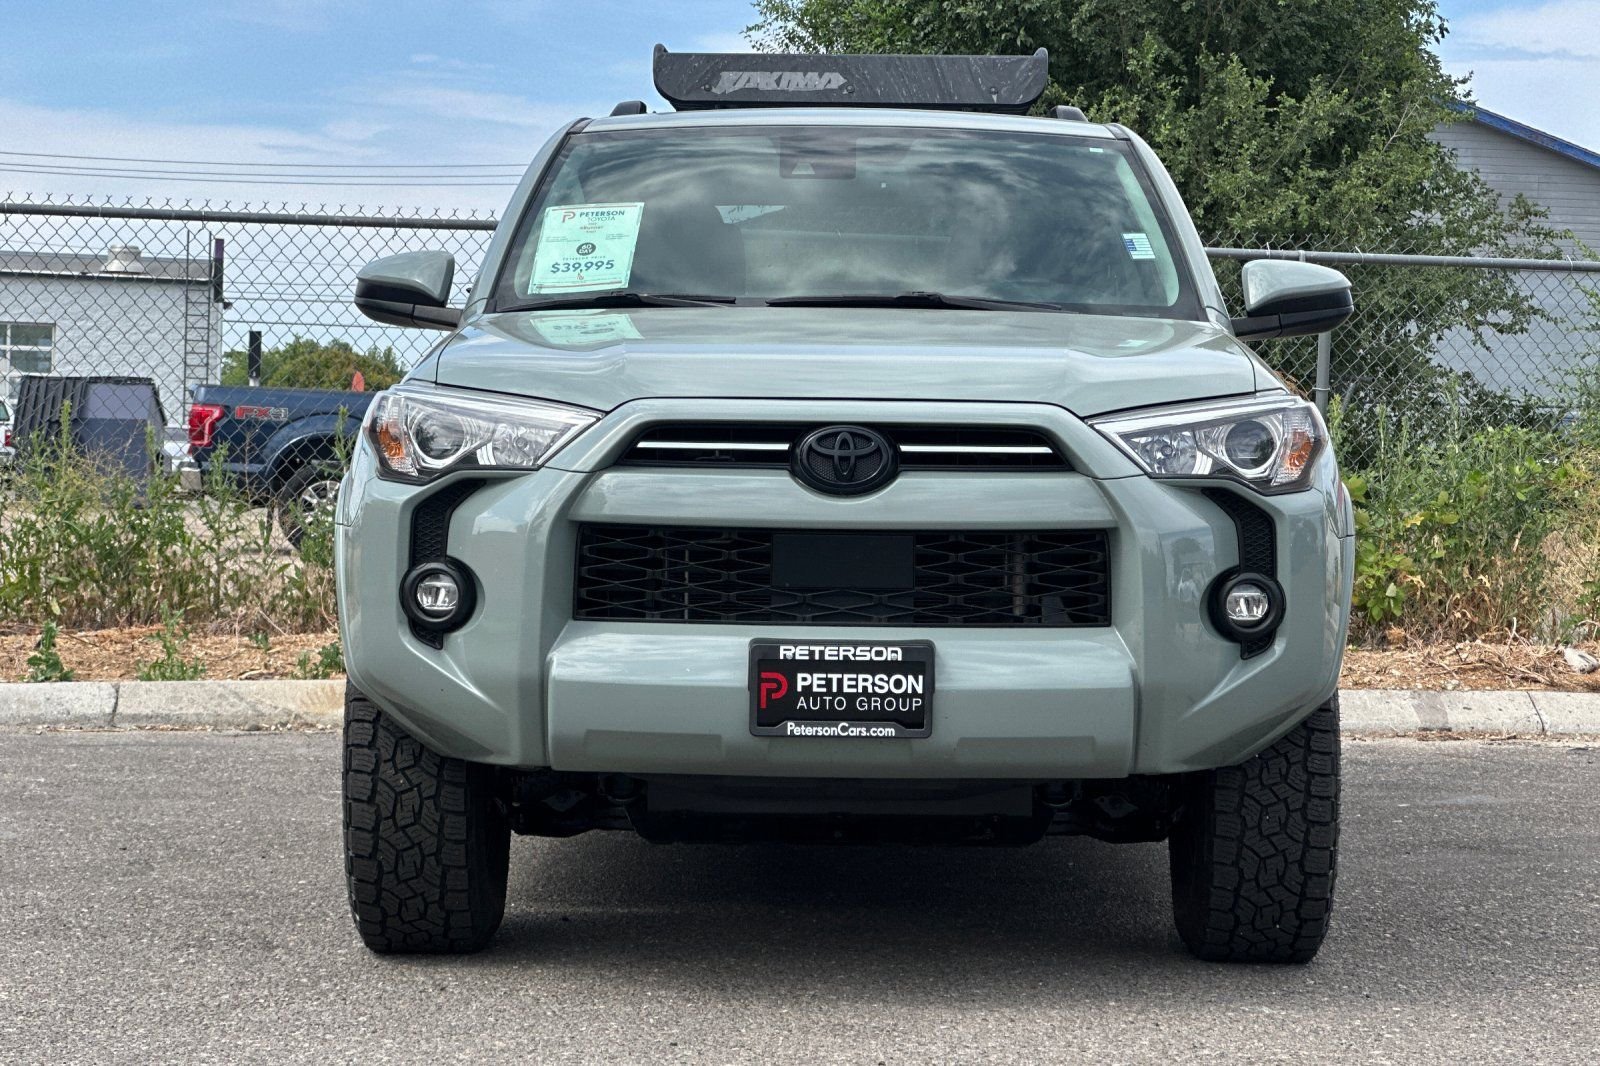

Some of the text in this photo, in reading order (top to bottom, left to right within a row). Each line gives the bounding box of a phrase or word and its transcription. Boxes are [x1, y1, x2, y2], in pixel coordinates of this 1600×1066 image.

[712, 71, 848, 94] YAKIMA
[550, 260, 615, 274] $39,995
[235, 405, 288, 420] FX4
[779, 645, 902, 661] PETERSON
[796, 672, 923, 694] PETERSON
[796, 696, 922, 711] AUTO GROUP
[787, 722, 895, 737] PetersonCars.com
